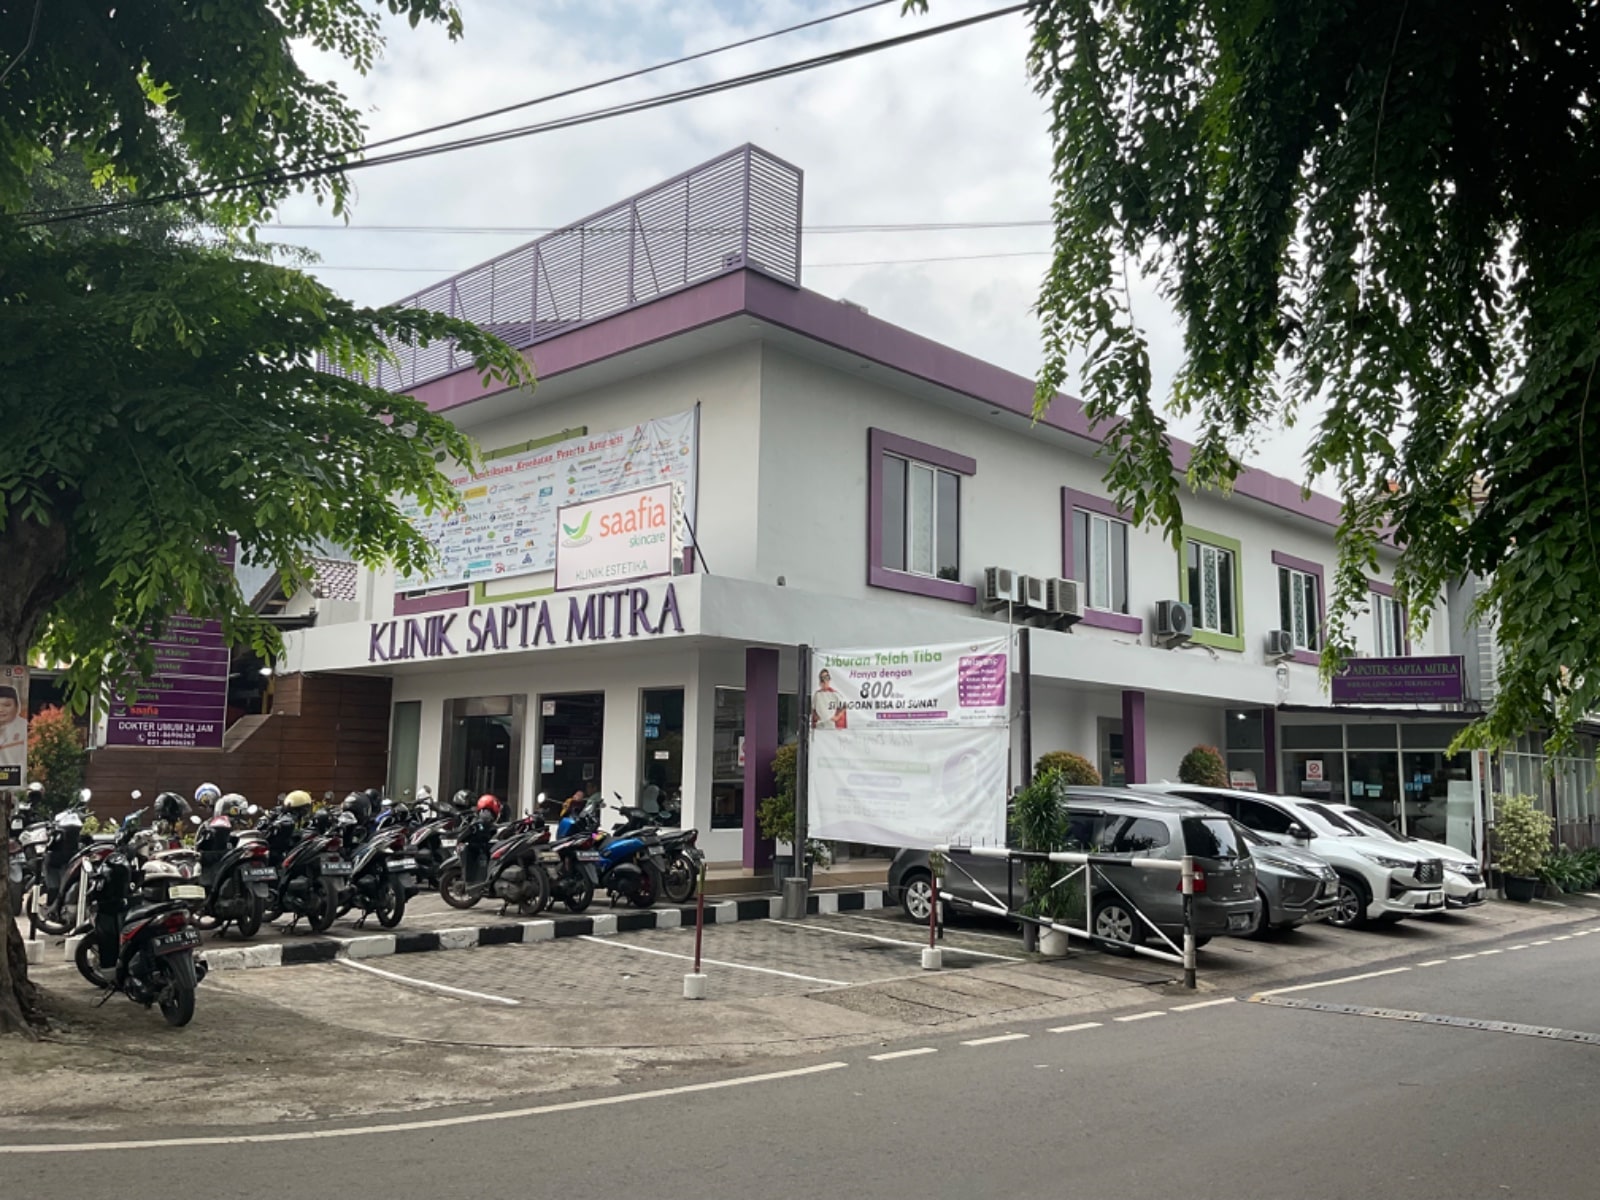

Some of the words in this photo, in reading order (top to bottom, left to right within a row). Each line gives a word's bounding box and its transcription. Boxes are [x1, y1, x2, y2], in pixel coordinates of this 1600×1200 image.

[557, 446, 585, 460] Peserta
[600, 496, 666, 538] saafia
[629, 532, 666, 548] skincare
[575, 567, 604, 581] KLINIK
[605, 560, 648, 577] ESTETIKA
[368, 612, 458, 663] KLINIK
[466, 600, 556, 653] SAPTA
[565, 582, 685, 643] MITRA
[825, 655, 870, 667] Liburan
[875, 652, 908, 666] Telah
[913, 650, 942, 663] Tiba
[849, 670, 877, 679] Hanya
[879, 668, 912, 679] dengan
[1352, 665, 1389, 675] APOTEK
[1392, 664, 1423, 674] SAPTA
[1425, 663, 1458, 673] MITRA
[860, 681, 893, 699] 800
[838, 700, 873, 710] JAGOAN
[875, 700, 893, 709] BISA
[895, 700, 905, 709] DI
[908, 699, 938, 709] SUNAT
[119, 721, 155, 731] DOKTER
[157, 722, 183, 732] UMUM
[185, 723, 195, 732] 24
[196, 724, 214, 733] JAM
